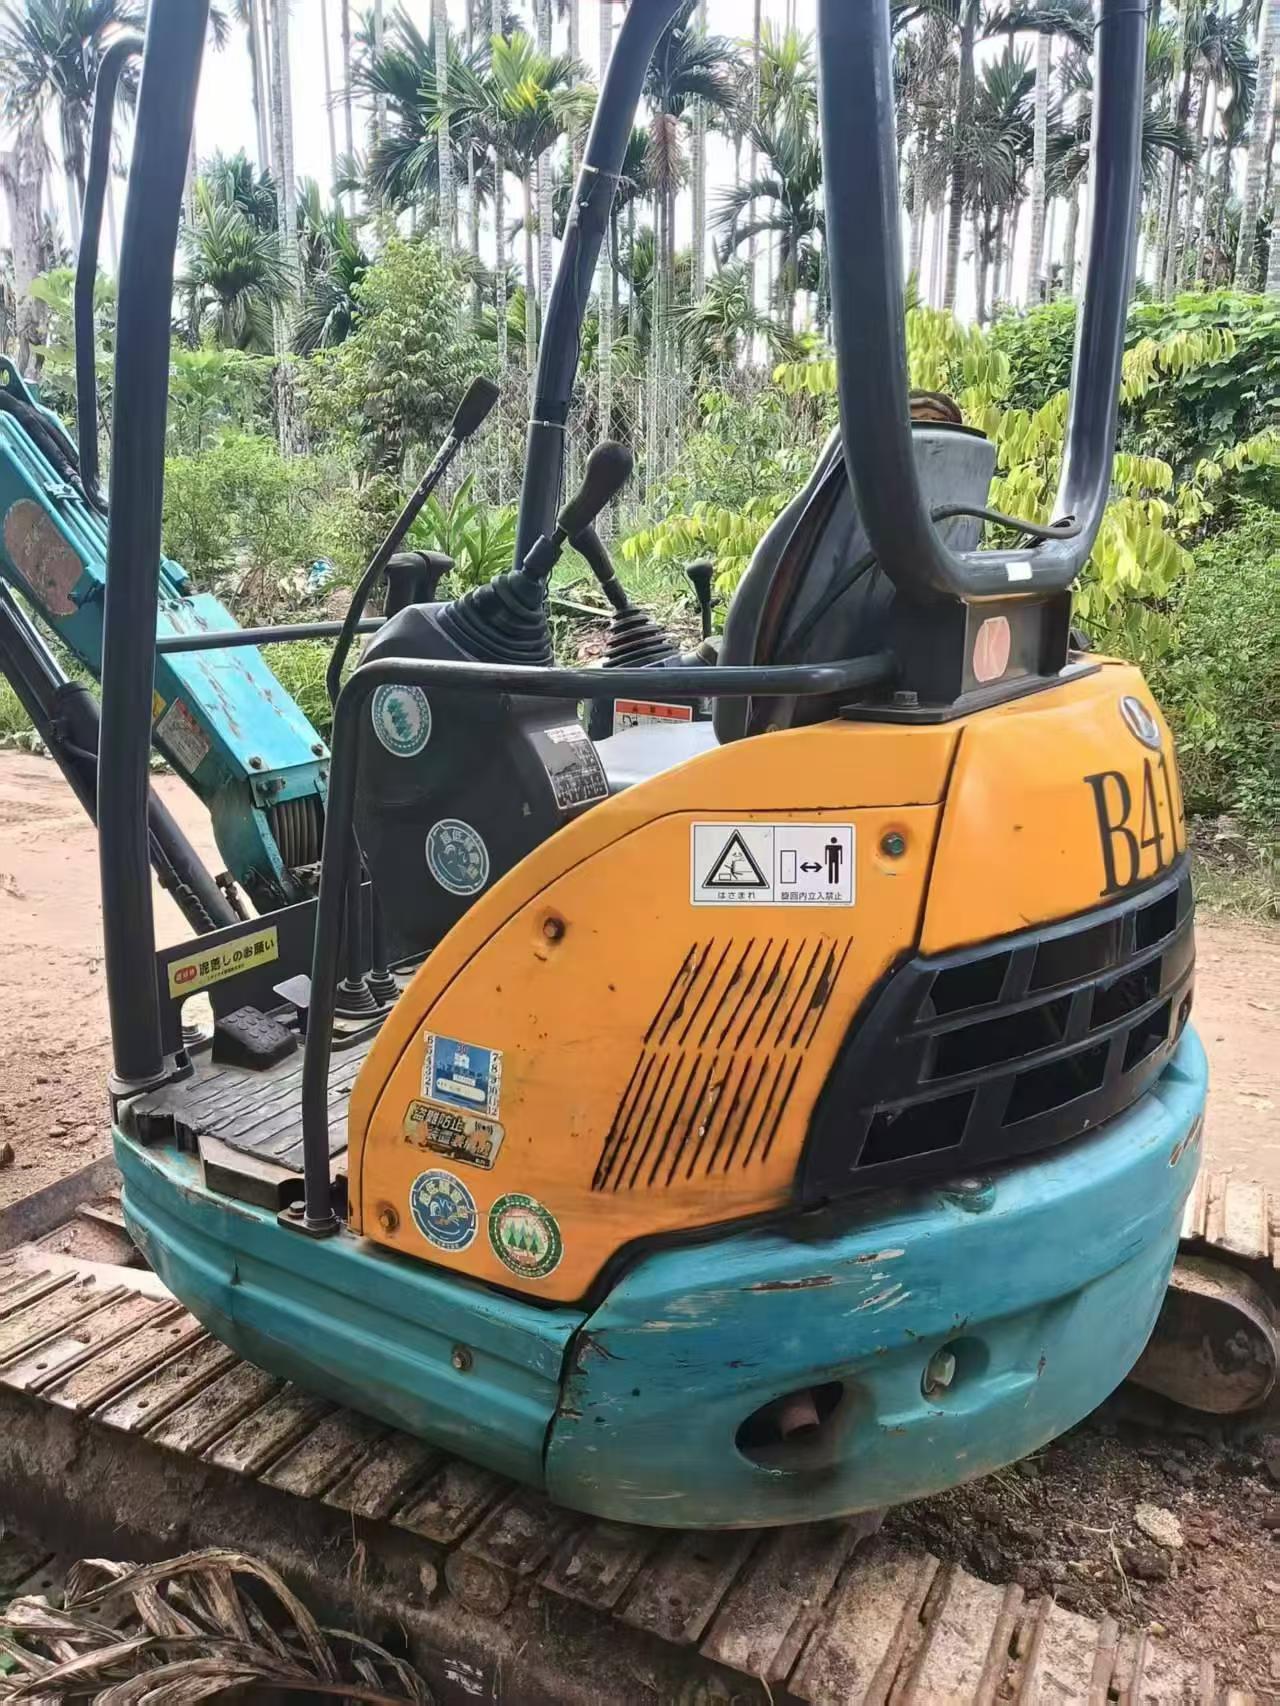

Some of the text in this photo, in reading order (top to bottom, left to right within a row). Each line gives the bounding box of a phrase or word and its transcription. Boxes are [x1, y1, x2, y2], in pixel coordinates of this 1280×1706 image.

[1083, 751, 1184, 897] B41
[717, 891, 756, 900] はさまれ
[781, 891, 843, 901] 旋回内立入禁止
